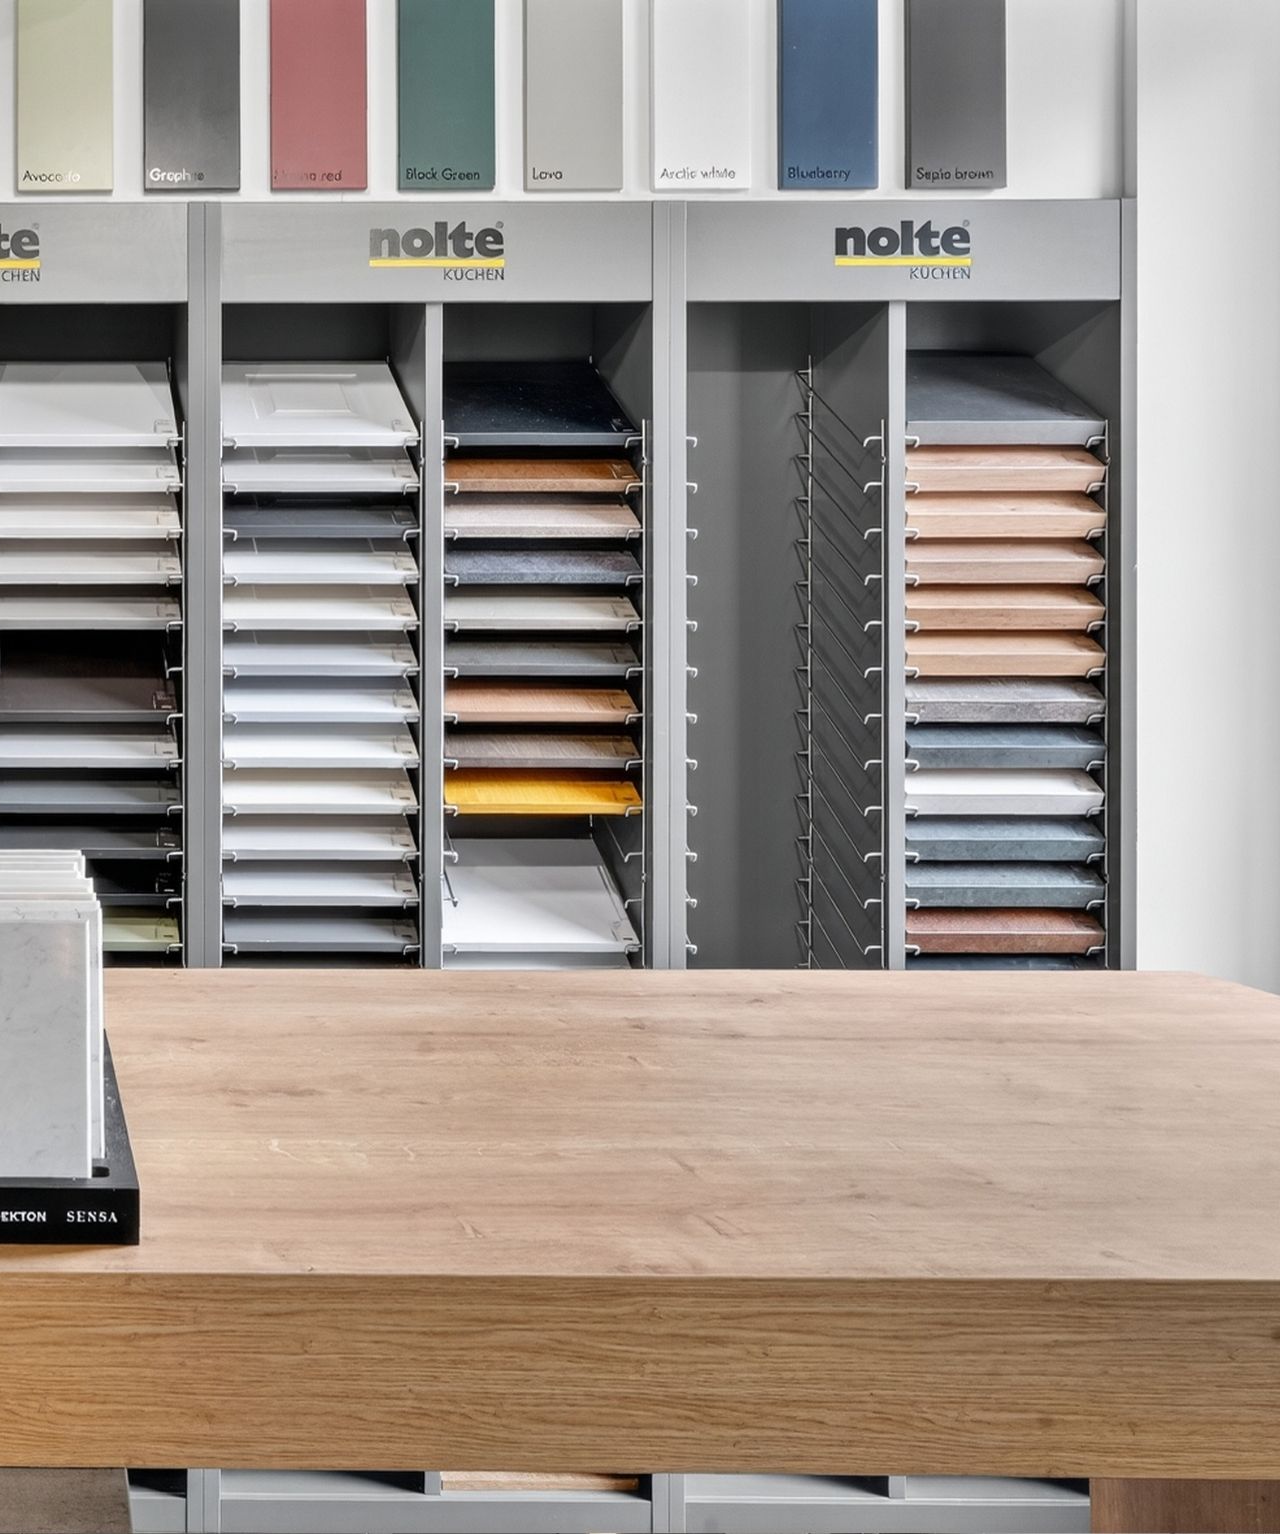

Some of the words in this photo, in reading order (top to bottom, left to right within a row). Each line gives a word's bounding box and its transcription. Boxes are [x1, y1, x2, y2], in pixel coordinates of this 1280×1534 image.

[322, 170, 342, 183] red
[406, 168, 437, 180] Black
[440, 168, 480, 180] Green
[533, 168, 562, 180] Lava
[788, 166, 850, 183] Blueberry
[917, 167, 952, 184] Sepia
[954, 167, 994, 180] brown
[370, 221, 504, 258] nolte
[835, 220, 970, 256] nolte
[67, 1211, 117, 1222] SENSA
